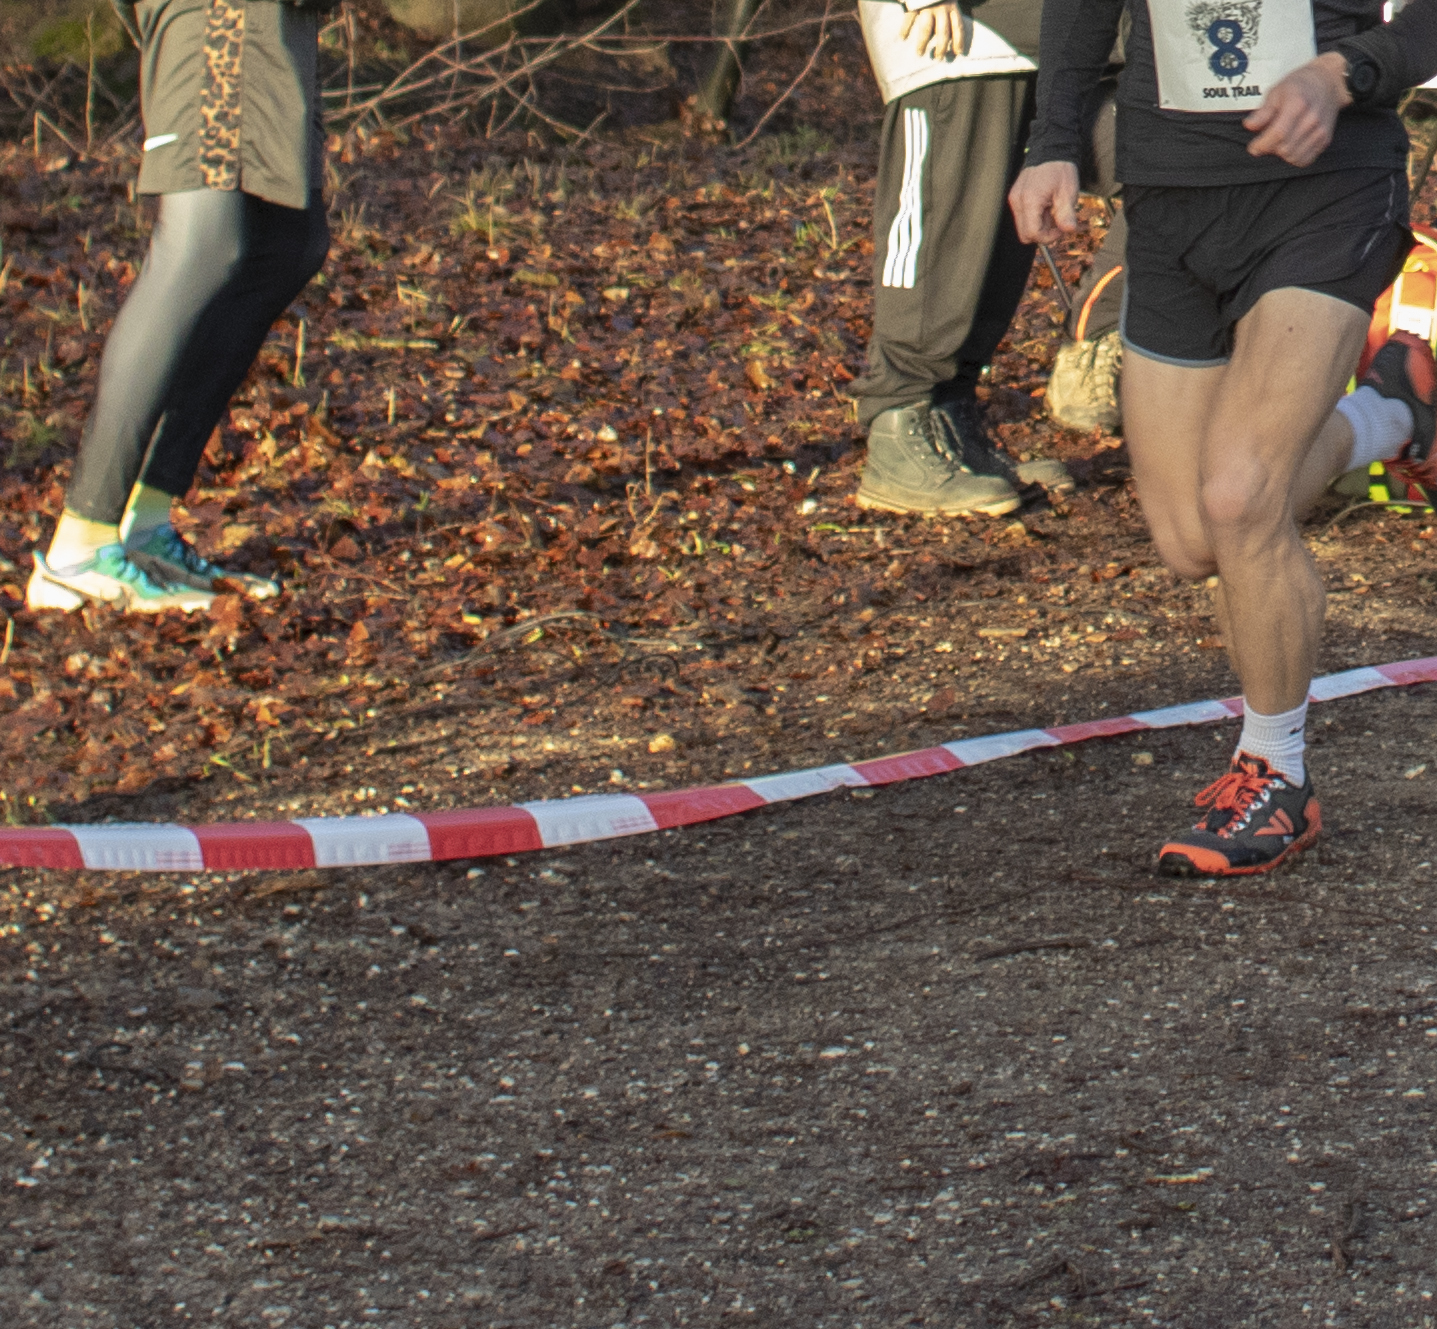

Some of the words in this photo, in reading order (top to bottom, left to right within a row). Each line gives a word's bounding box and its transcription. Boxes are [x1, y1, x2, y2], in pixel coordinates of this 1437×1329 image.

[1208, 18, 1249, 78] 8
[1203, 87, 1230, 99] SOUL
[1231, 85, 1262, 98] TRAIL
